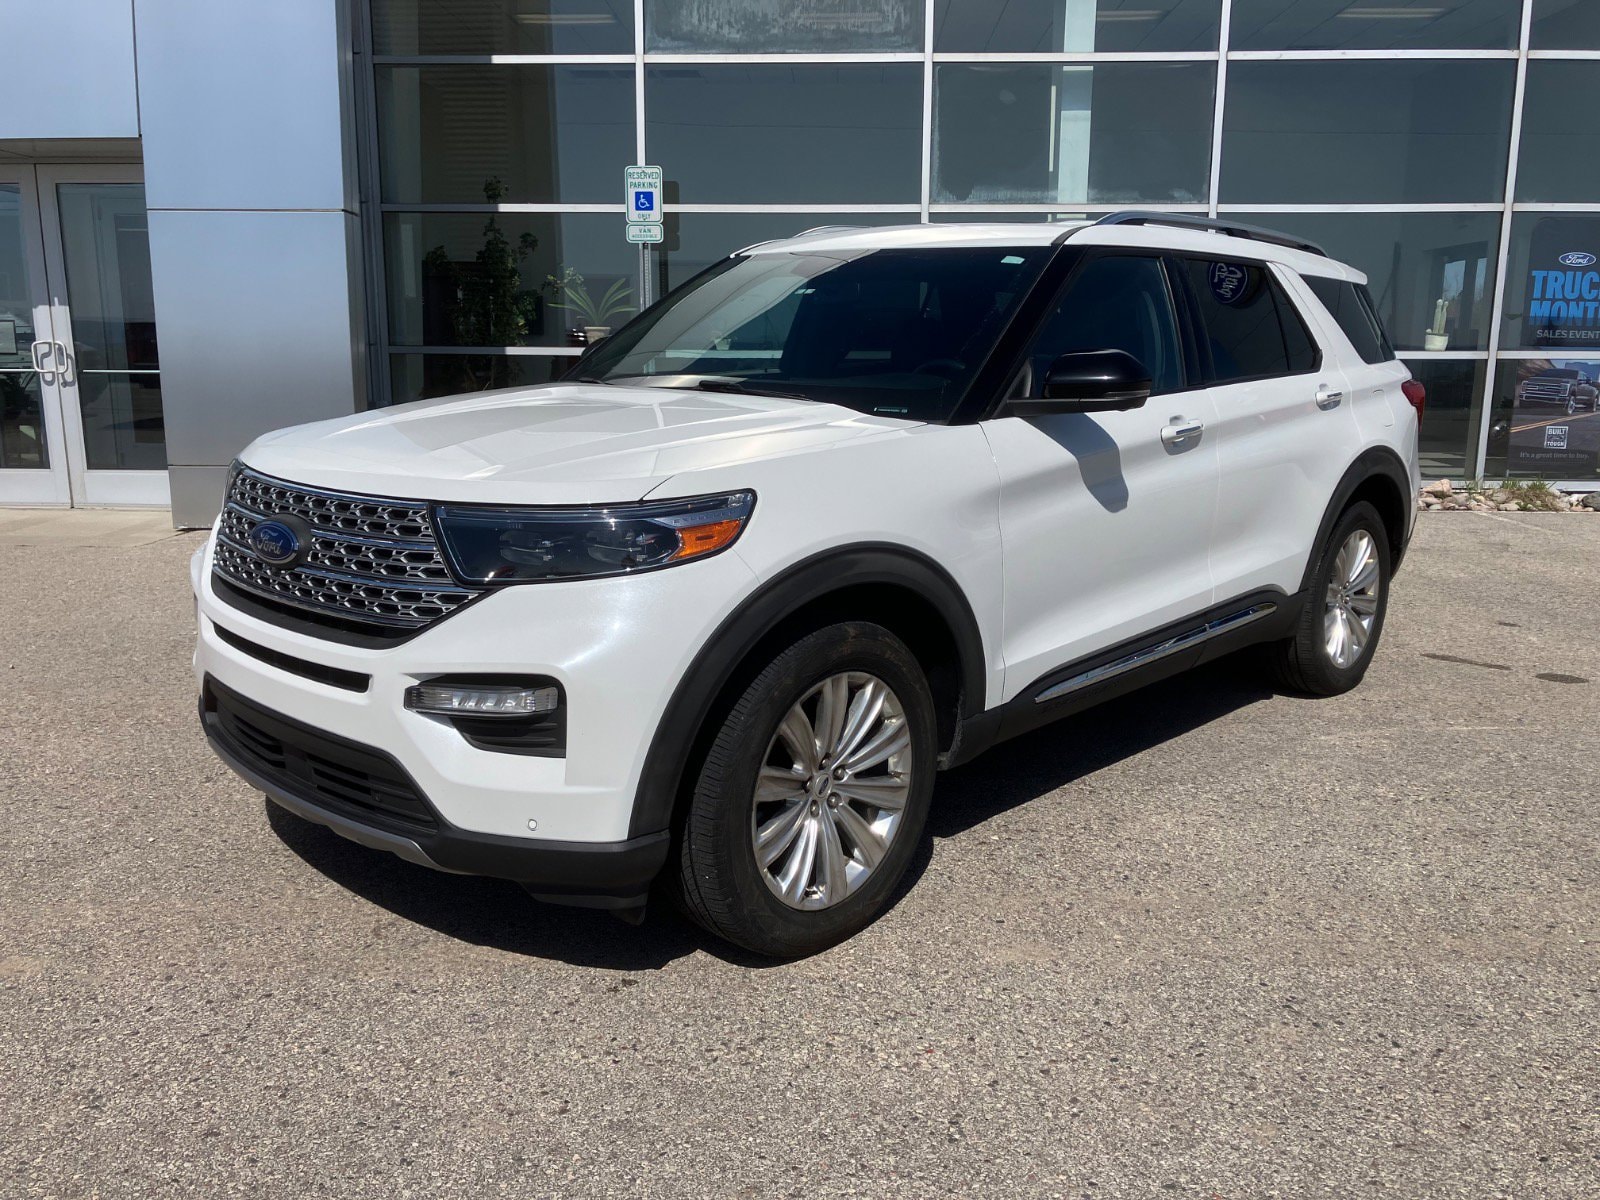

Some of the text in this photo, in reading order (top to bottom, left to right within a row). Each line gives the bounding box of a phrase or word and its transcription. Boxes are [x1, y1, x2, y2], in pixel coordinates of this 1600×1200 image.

[628, 171, 659, 179] RESERVED
[629, 181, 658, 189] PARKING
[1531, 270, 1600, 300] TRUC
[1528, 300, 1600, 327] MONT
[1536, 329, 1600, 339] SALES EVENT
